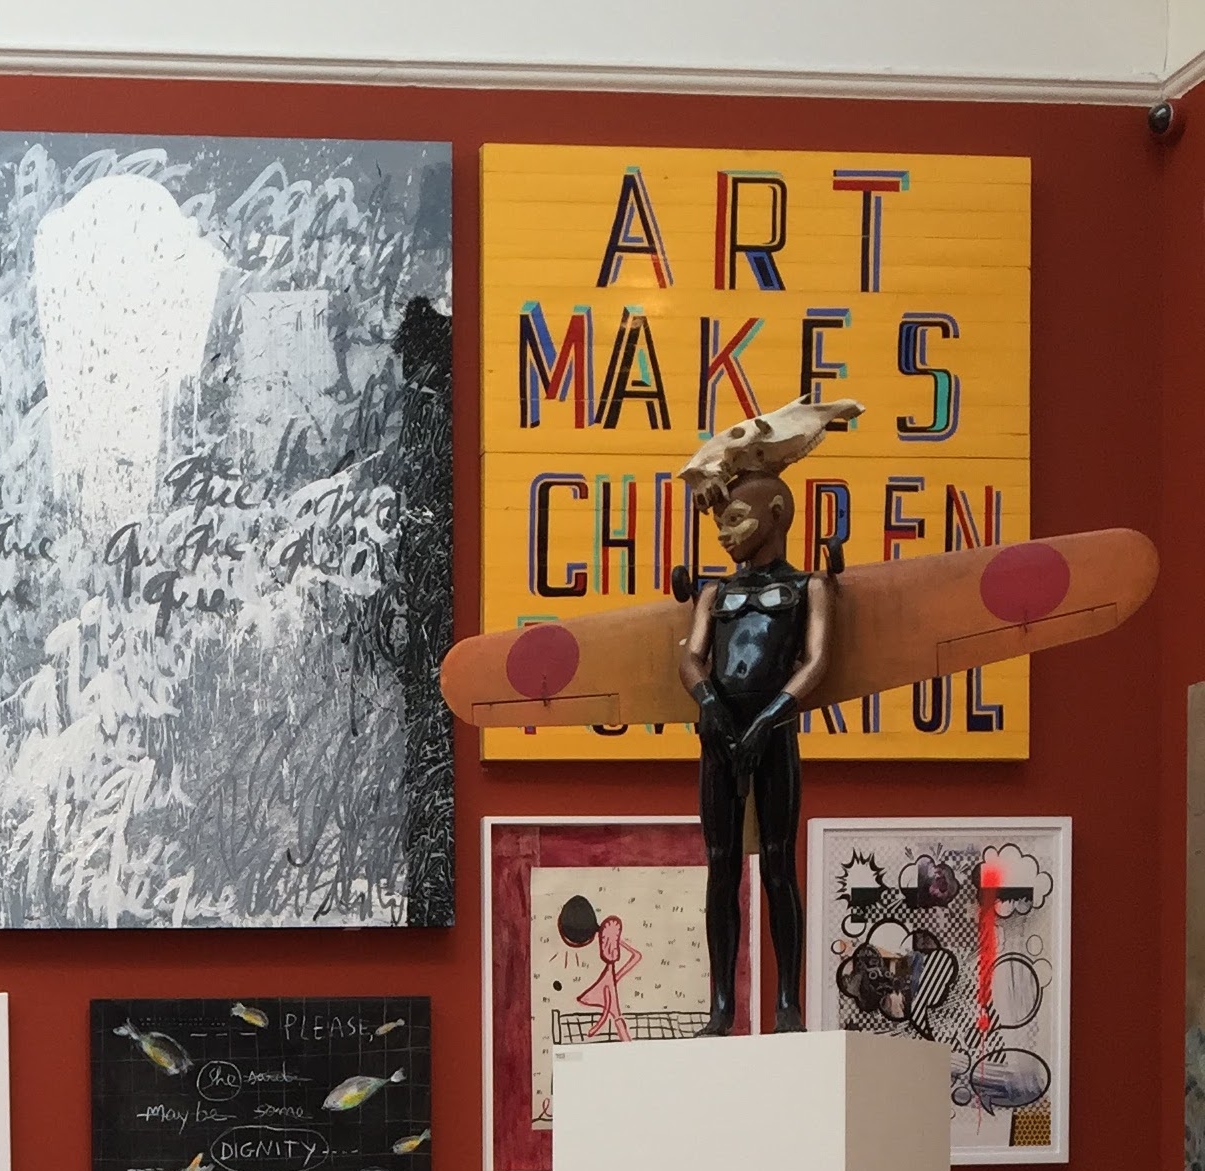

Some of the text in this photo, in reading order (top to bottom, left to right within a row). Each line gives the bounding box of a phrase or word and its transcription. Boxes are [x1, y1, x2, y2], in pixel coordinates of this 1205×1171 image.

[596, 165, 910, 293] ART
[519, 300, 961, 442] MAKES
[529, 472, 1003, 597] CHILREN
[220, 1140, 317, 1167] DIGNITY
